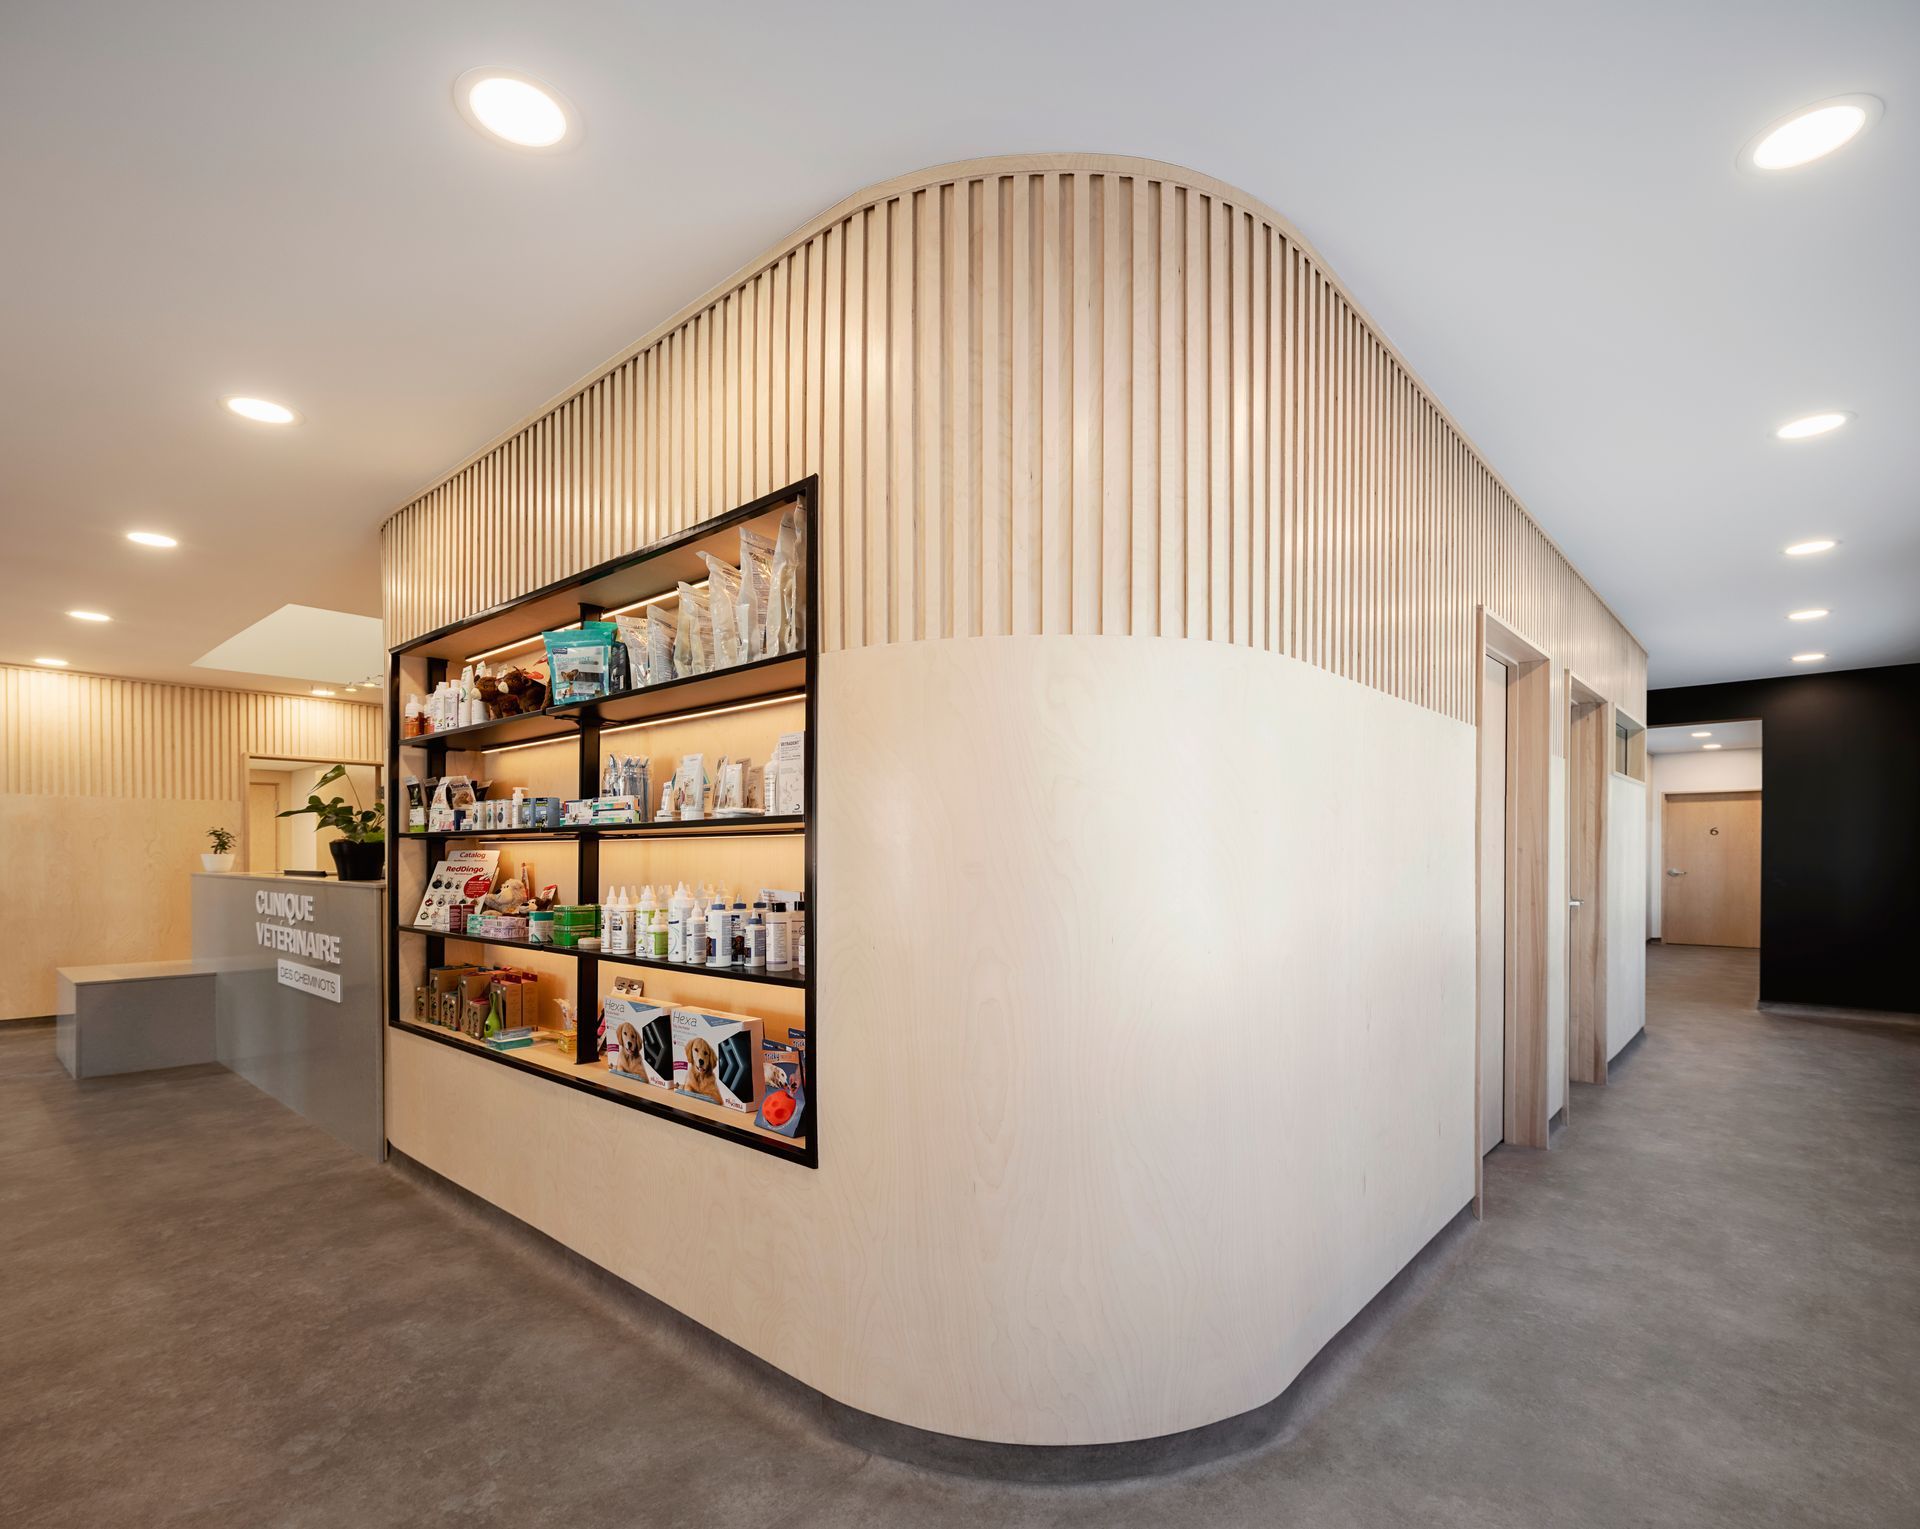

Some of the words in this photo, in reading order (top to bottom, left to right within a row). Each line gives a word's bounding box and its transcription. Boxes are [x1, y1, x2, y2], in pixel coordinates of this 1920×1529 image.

[1709, 826, 1719, 836] 6
[459, 851, 487, 859] Catalog
[446, 865, 484, 873] RedDingo
[255, 890, 314, 925] CLINIQUE
[255, 917, 341, 965] VÉTÉRINAIRE
[280, 966, 294, 981] DES
[294, 970, 337, 994] CHEMINOTS
[605, 999, 625, 1013] Hexa
[673, 1011, 698, 1027] Hexa
